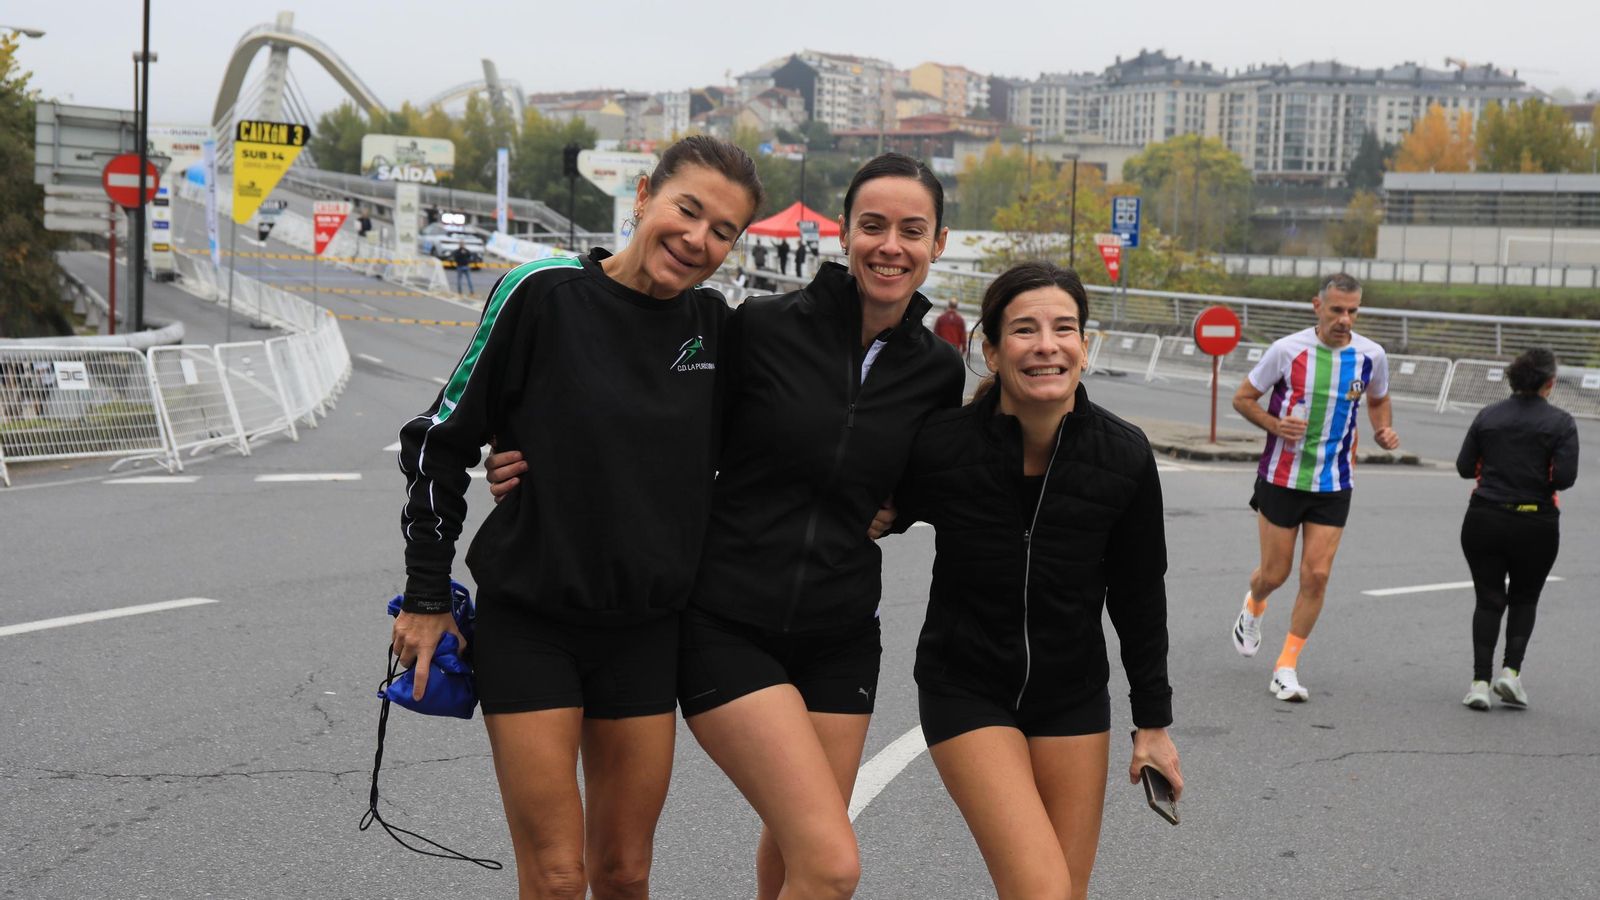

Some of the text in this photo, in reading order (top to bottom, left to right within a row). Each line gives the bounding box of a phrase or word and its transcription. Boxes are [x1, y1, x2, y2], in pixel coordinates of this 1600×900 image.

[293, 126, 304, 145] 3
[242, 149, 285, 161] SUB 14
